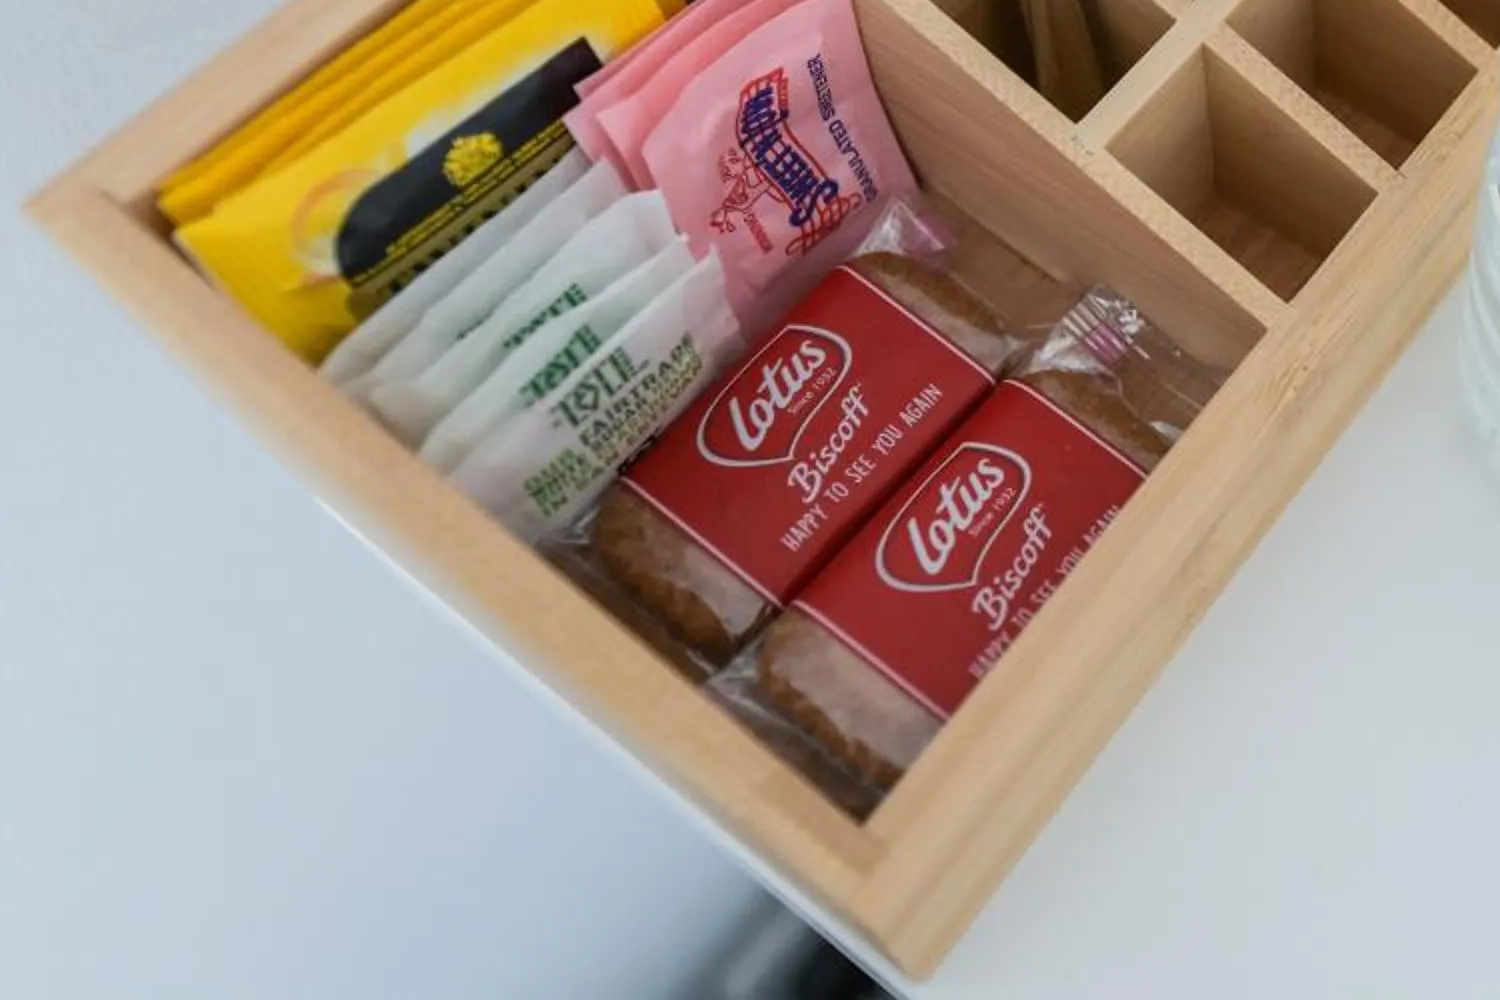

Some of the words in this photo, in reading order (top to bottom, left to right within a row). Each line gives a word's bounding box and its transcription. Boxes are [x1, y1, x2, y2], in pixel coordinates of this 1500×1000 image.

[829, 118, 878, 204] GRANULATED
[729, 339, 827, 451] Lotus
[814, 366, 836, 390] 1932
[780, 503, 829, 552] HAPPY
[823, 481, 849, 503] TO
[845, 454, 877, 483] SEE
[871, 424, 902, 456] YOU
[899, 383, 943, 428] AGAIN
[787, 385, 869, 503] Biscoff
[907, 457, 1004, 575] Lotus
[972, 505, 1053, 631] Biscoff
